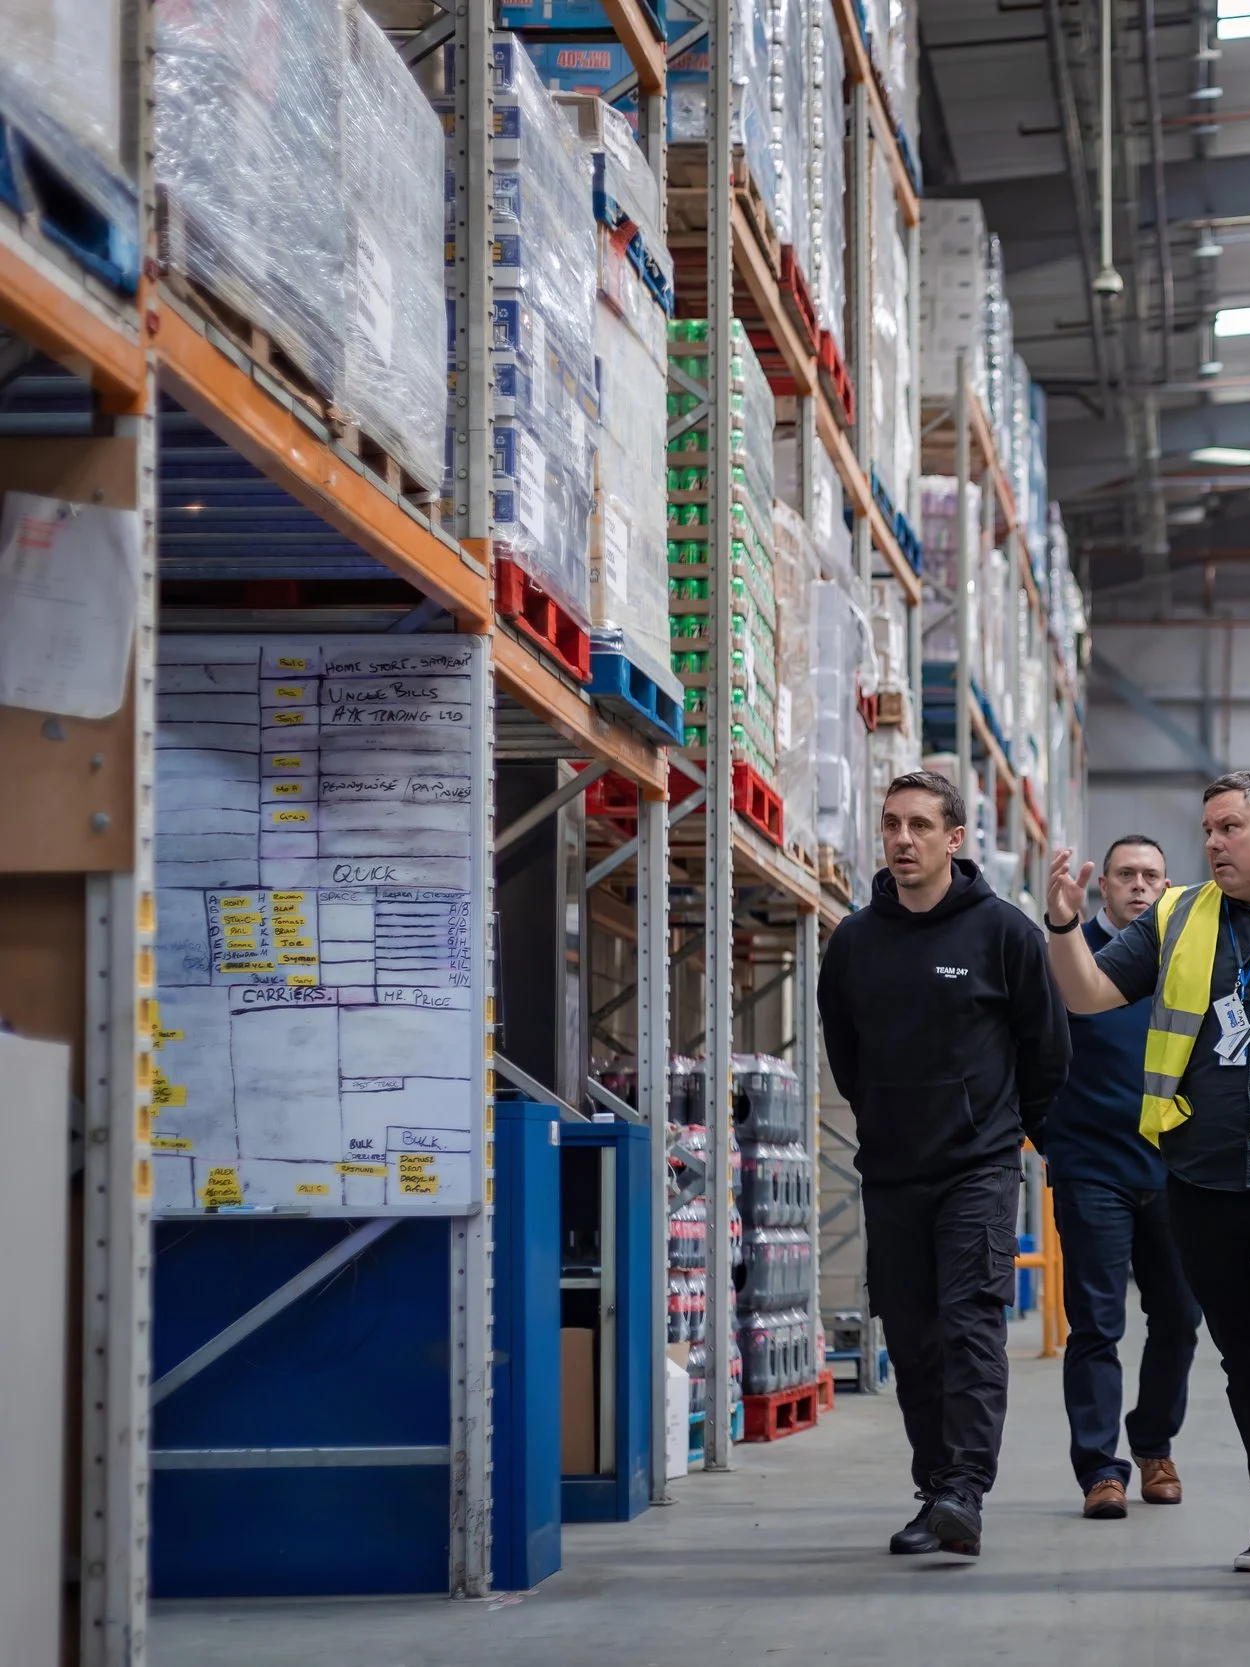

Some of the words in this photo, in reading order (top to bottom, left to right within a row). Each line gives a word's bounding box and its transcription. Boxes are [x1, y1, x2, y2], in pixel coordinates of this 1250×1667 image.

[325, 661, 362, 675] HOME
[390, 682, 439, 699] BILLS
[368, 707, 431, 722] TRADING
[440, 710, 463, 722] LTD
[332, 864, 398, 883] QUICK
[936, 966, 955, 974] TEAM
[956, 968, 969, 976] 247
[413, 988, 451, 1006] PRICE
[349, 1138, 373, 1149] BULK
